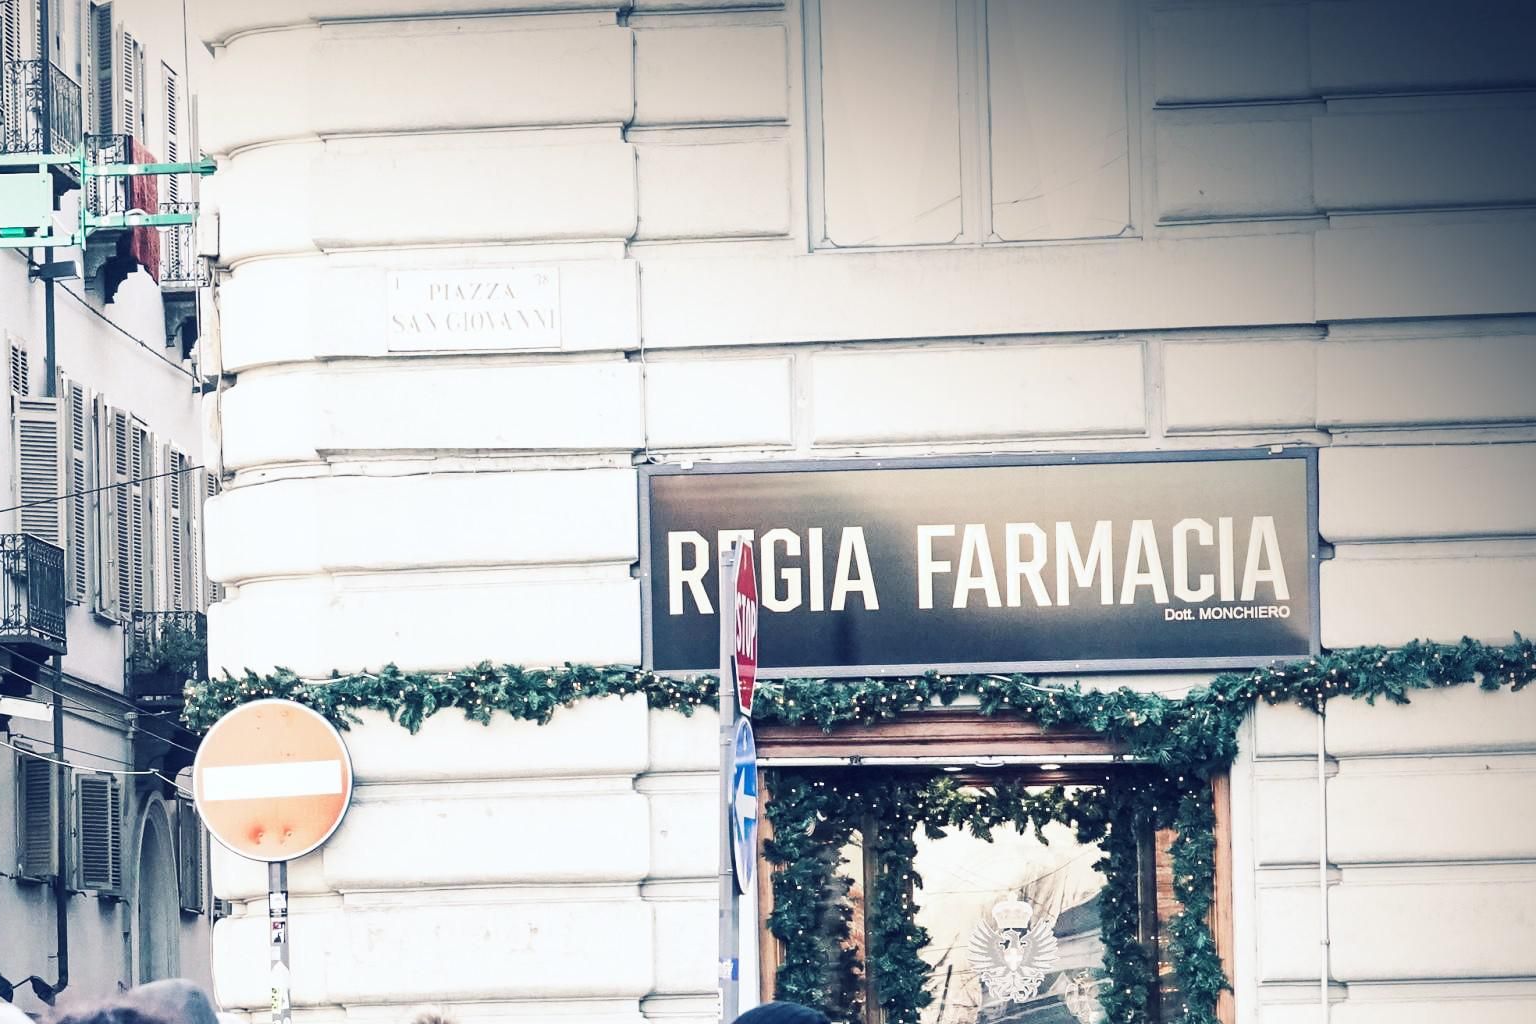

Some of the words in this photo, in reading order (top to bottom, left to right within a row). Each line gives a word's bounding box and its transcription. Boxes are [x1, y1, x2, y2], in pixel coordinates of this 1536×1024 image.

[429, 283, 516, 300] PIAZZA
[392, 312, 438, 333] SAN
[446, 310, 554, 331] GIOVANNI
[917, 516, 1290, 610] FARMACIA
[1164, 608, 1195, 621] Dott.
[1199, 605, 1291, 620] MONCHIERO
[736, 591, 756, 661] STOP
